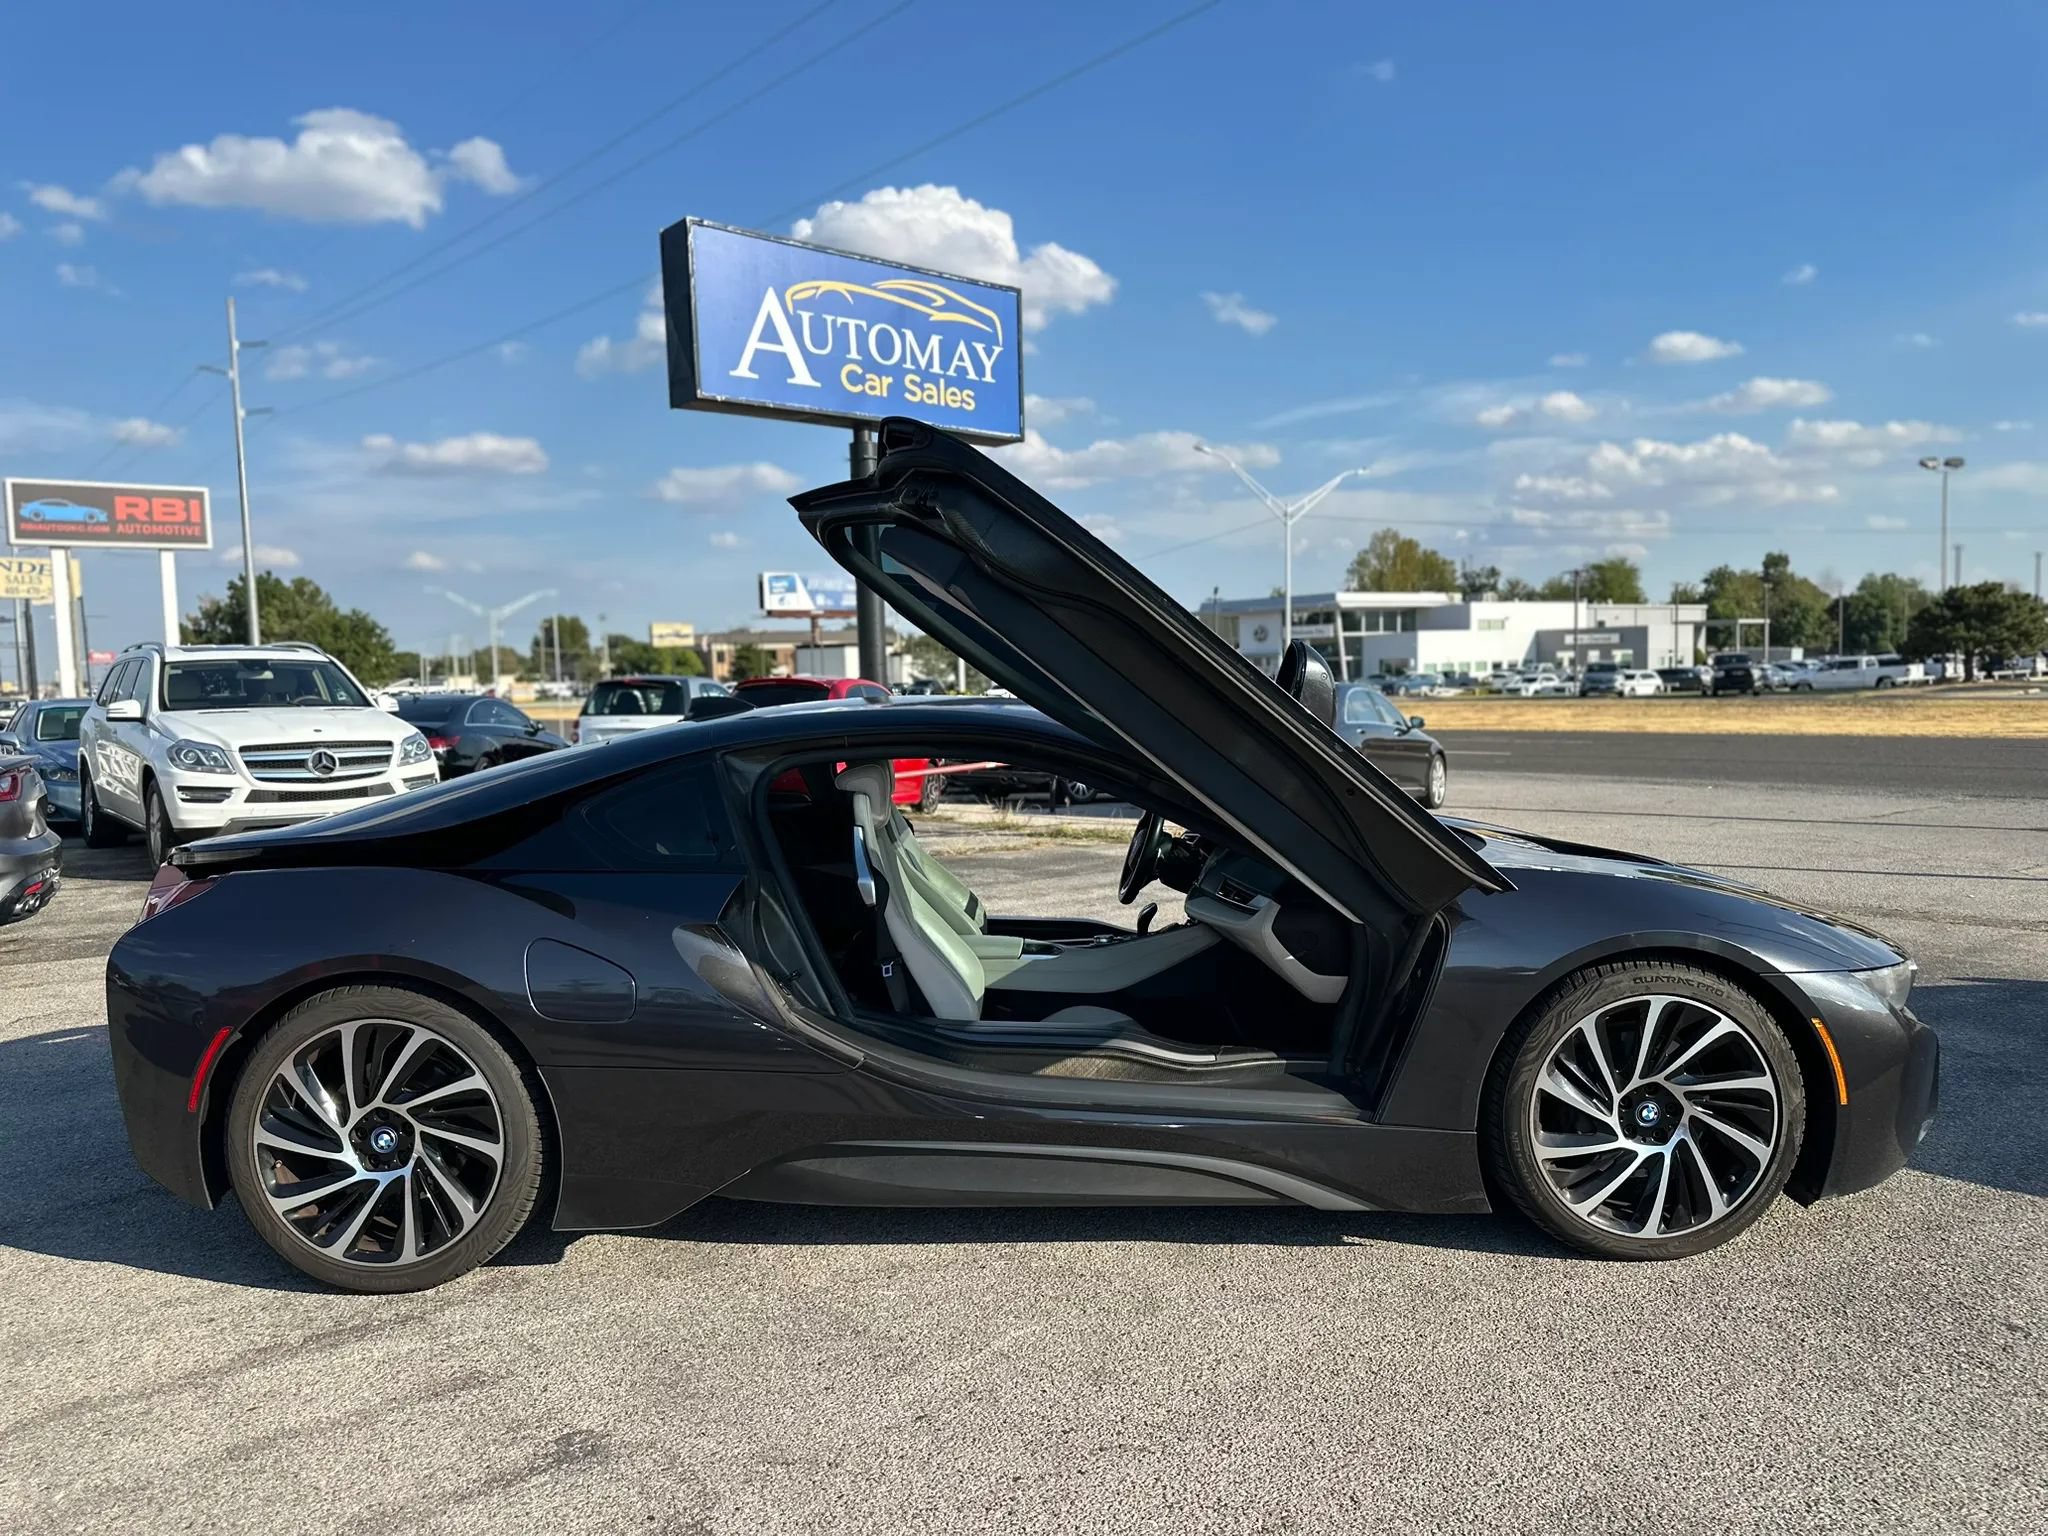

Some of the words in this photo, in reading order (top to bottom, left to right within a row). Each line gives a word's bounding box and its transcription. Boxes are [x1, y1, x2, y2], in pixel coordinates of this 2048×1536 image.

[728, 286, 1004, 388] AUTOMAY
[840, 363, 894, 398] Car
[903, 374, 976, 411] Sales
[114, 495, 202, 523] RBI
[116, 523, 202, 537] AUTOMOTIVE
[1632, 975, 1695, 987] QUATRAC
[1696, 981, 1725, 998] PRO
